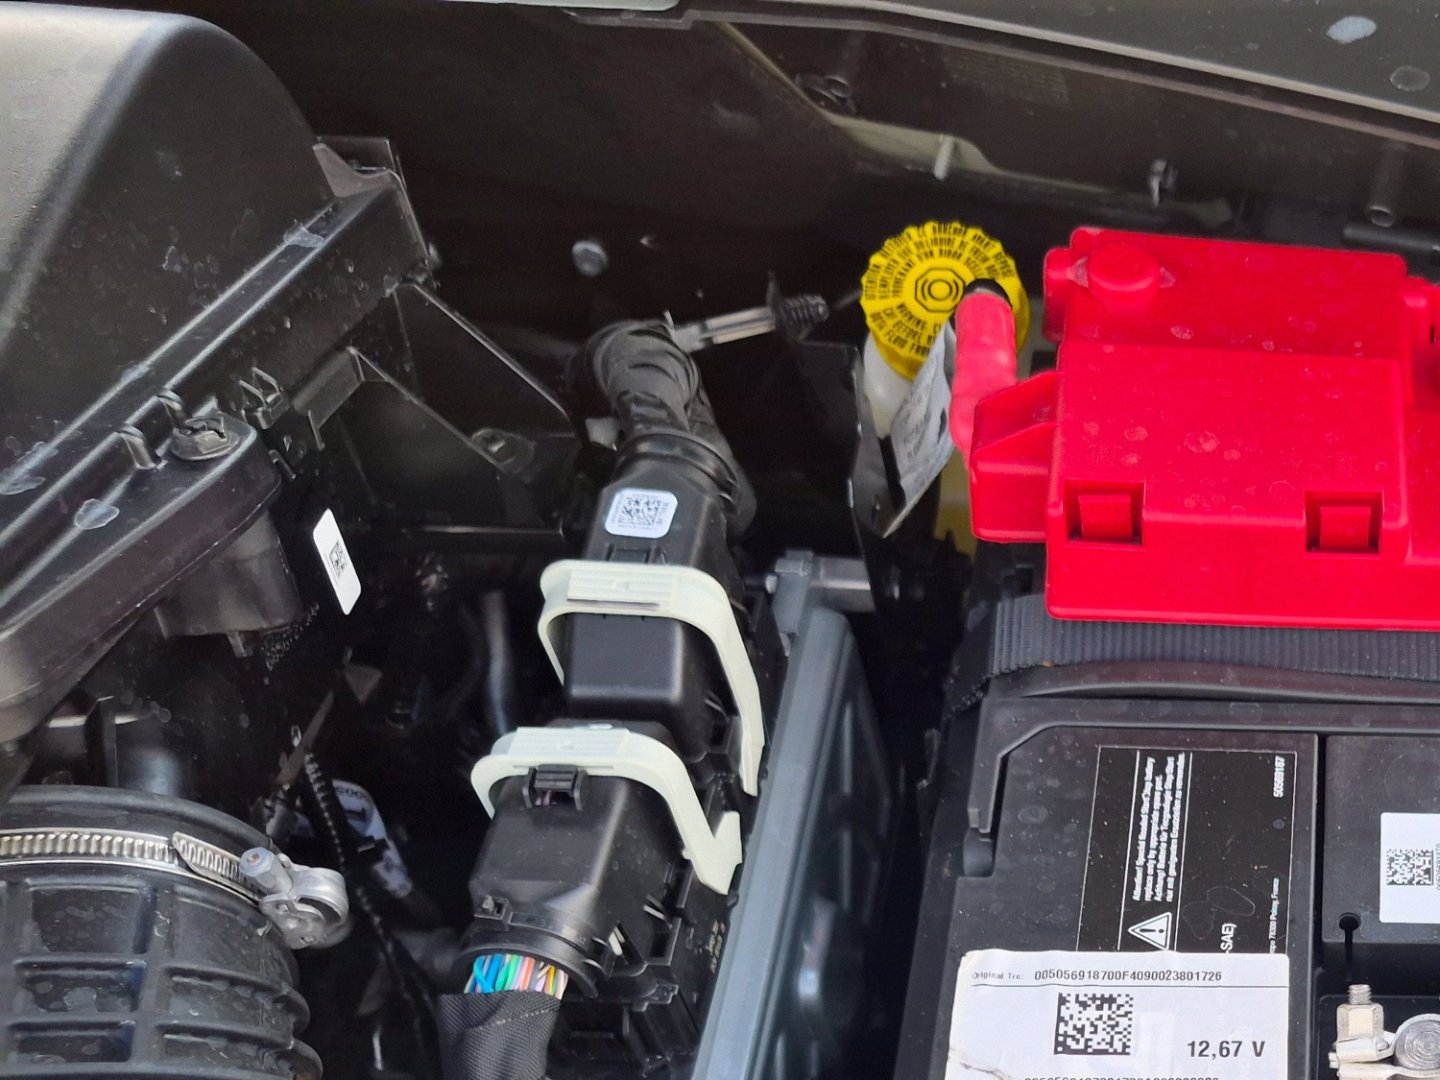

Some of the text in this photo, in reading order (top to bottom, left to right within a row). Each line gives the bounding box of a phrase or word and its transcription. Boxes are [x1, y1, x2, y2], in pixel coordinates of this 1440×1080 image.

[1034, 969, 1222, 981] 005056918700F4090023801726
[1187, 1040, 1266, 1060] 12,67 V
